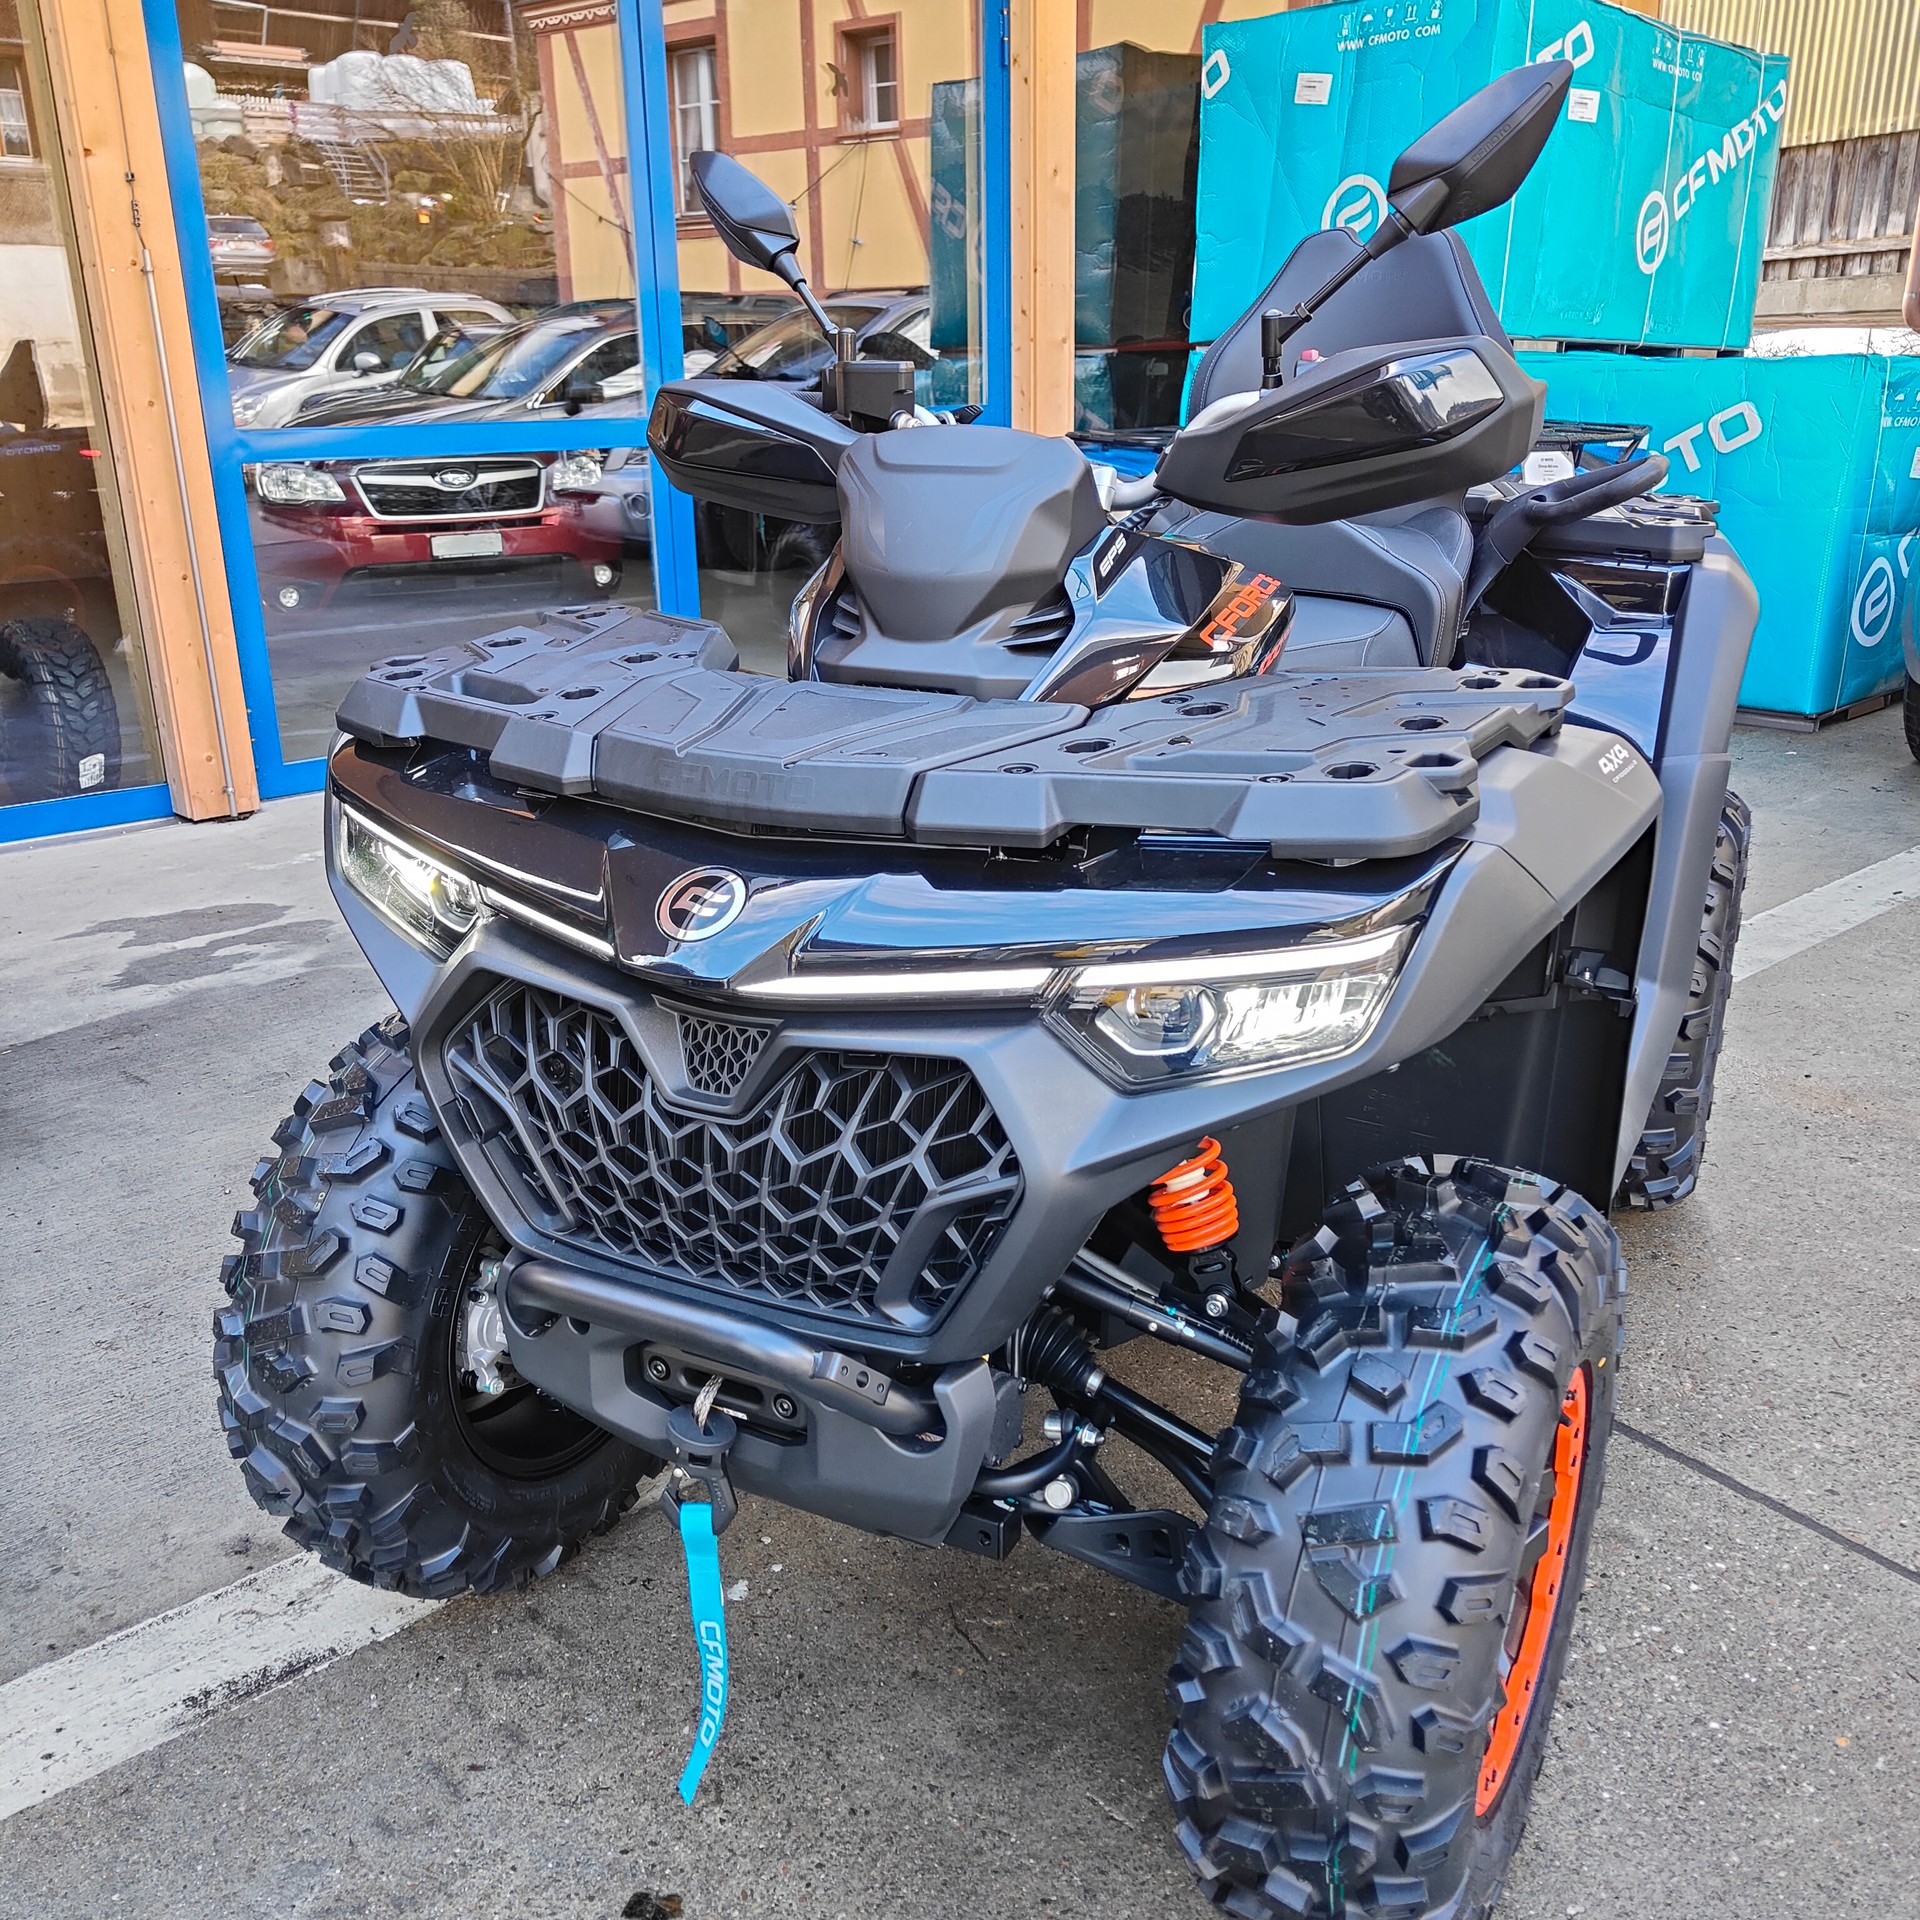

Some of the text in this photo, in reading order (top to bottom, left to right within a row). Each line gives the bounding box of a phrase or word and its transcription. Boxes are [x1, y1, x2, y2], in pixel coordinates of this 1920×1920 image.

[1672, 79, 1787, 222] CFMOTO
[1099, 532, 1127, 577] EPS
[653, 757, 816, 804] CFMOTO
[699, 1620, 724, 1748] CFMOTO
